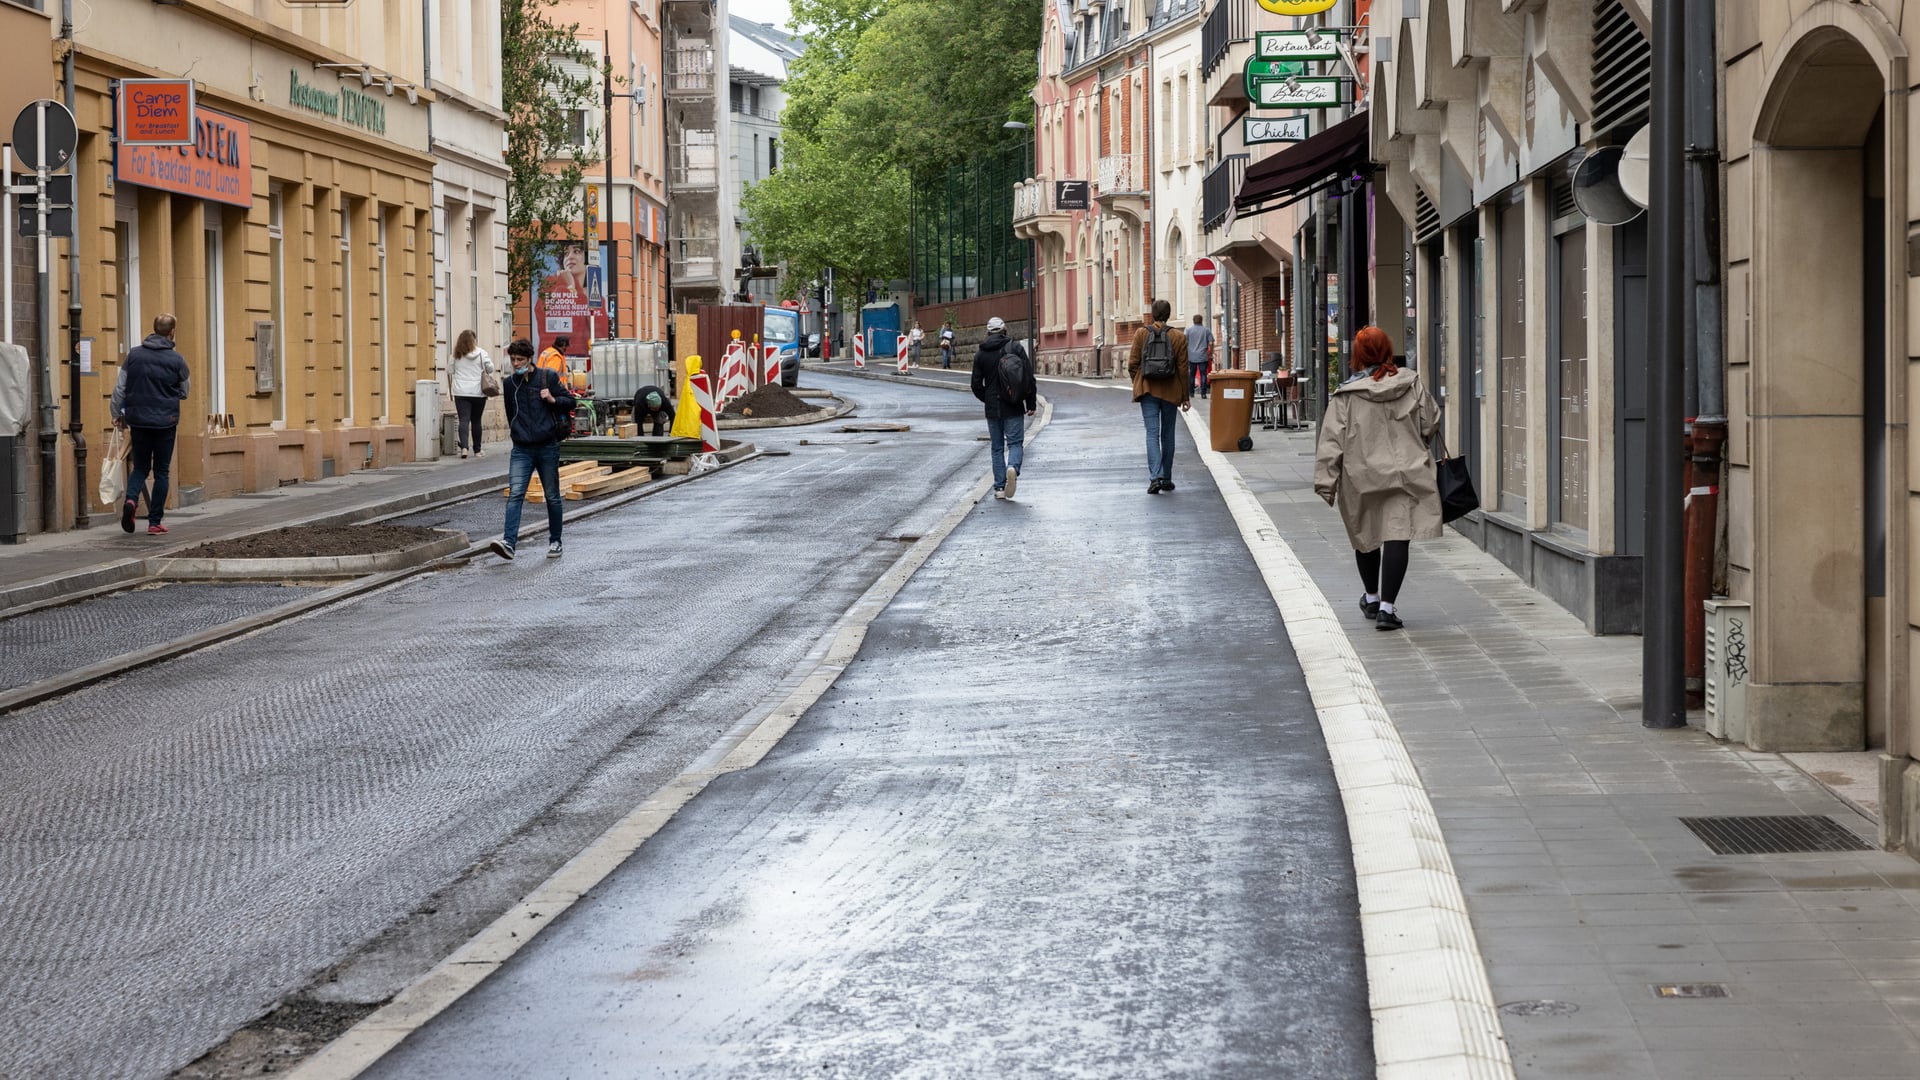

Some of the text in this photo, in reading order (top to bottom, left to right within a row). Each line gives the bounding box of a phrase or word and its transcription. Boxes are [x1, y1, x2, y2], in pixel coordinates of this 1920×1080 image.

[1265, 38, 1331, 53] Restaurant
[133, 91, 181, 106] Carpe
[290, 67, 386, 135] Restaurant TEMPURA
[137, 105, 178, 118] Diem
[1251, 122, 1300, 139] Chiche!
[195, 116, 240, 168] DIEM
[131, 147, 147, 174] For
[150, 152, 191, 185] Breakfast
[195, 168, 211, 190] and
[215, 168, 240, 196] Lunch
